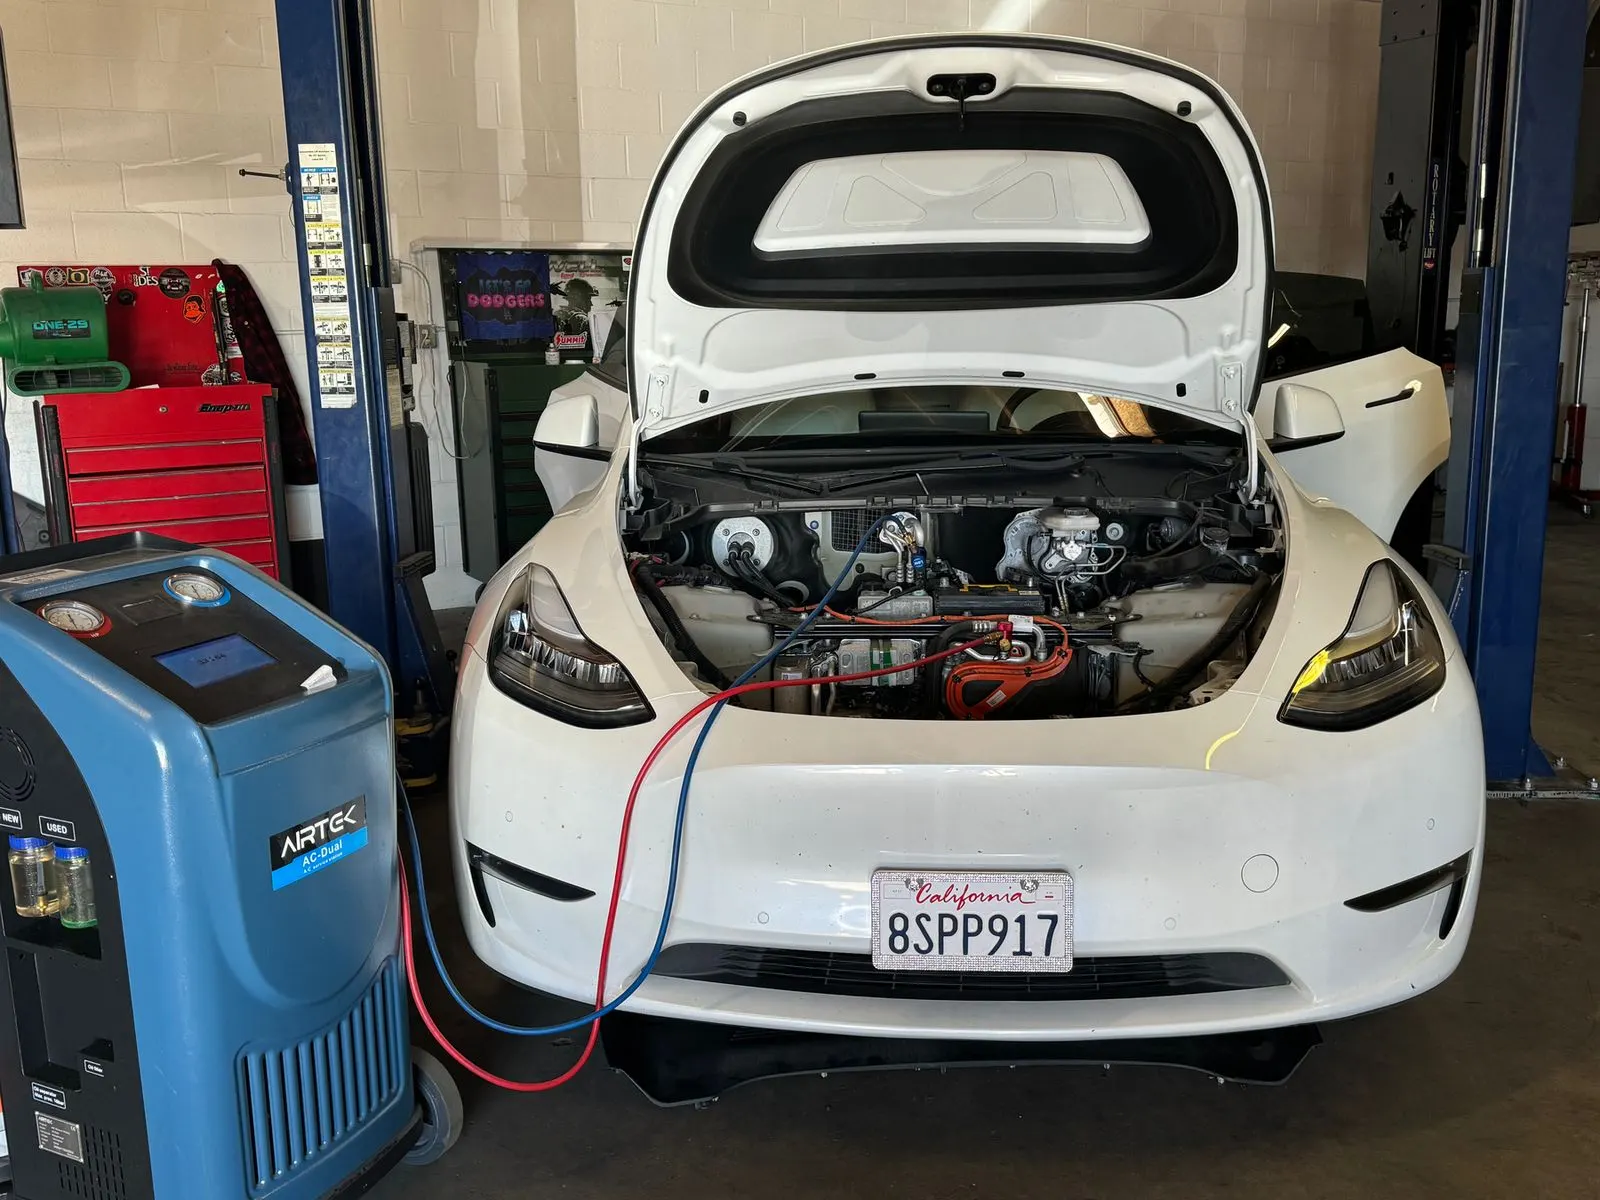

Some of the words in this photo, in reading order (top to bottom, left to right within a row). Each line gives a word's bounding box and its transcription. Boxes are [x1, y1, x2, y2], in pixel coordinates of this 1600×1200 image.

[1428, 164, 1439, 246] ROTARY
[1423, 248, 1436, 258] LIFT
[467, 294, 545, 308] DODGERS
[33, 320, 89, 331] ONE-29
[2, 813, 19, 824] NEW
[46, 822, 68, 834] USED
[281, 804, 357, 858] AIRTEK
[302, 839, 343, 867] AC-Dual
[915, 883, 1036, 911] California
[889, 912, 1059, 957] 8SPP917
